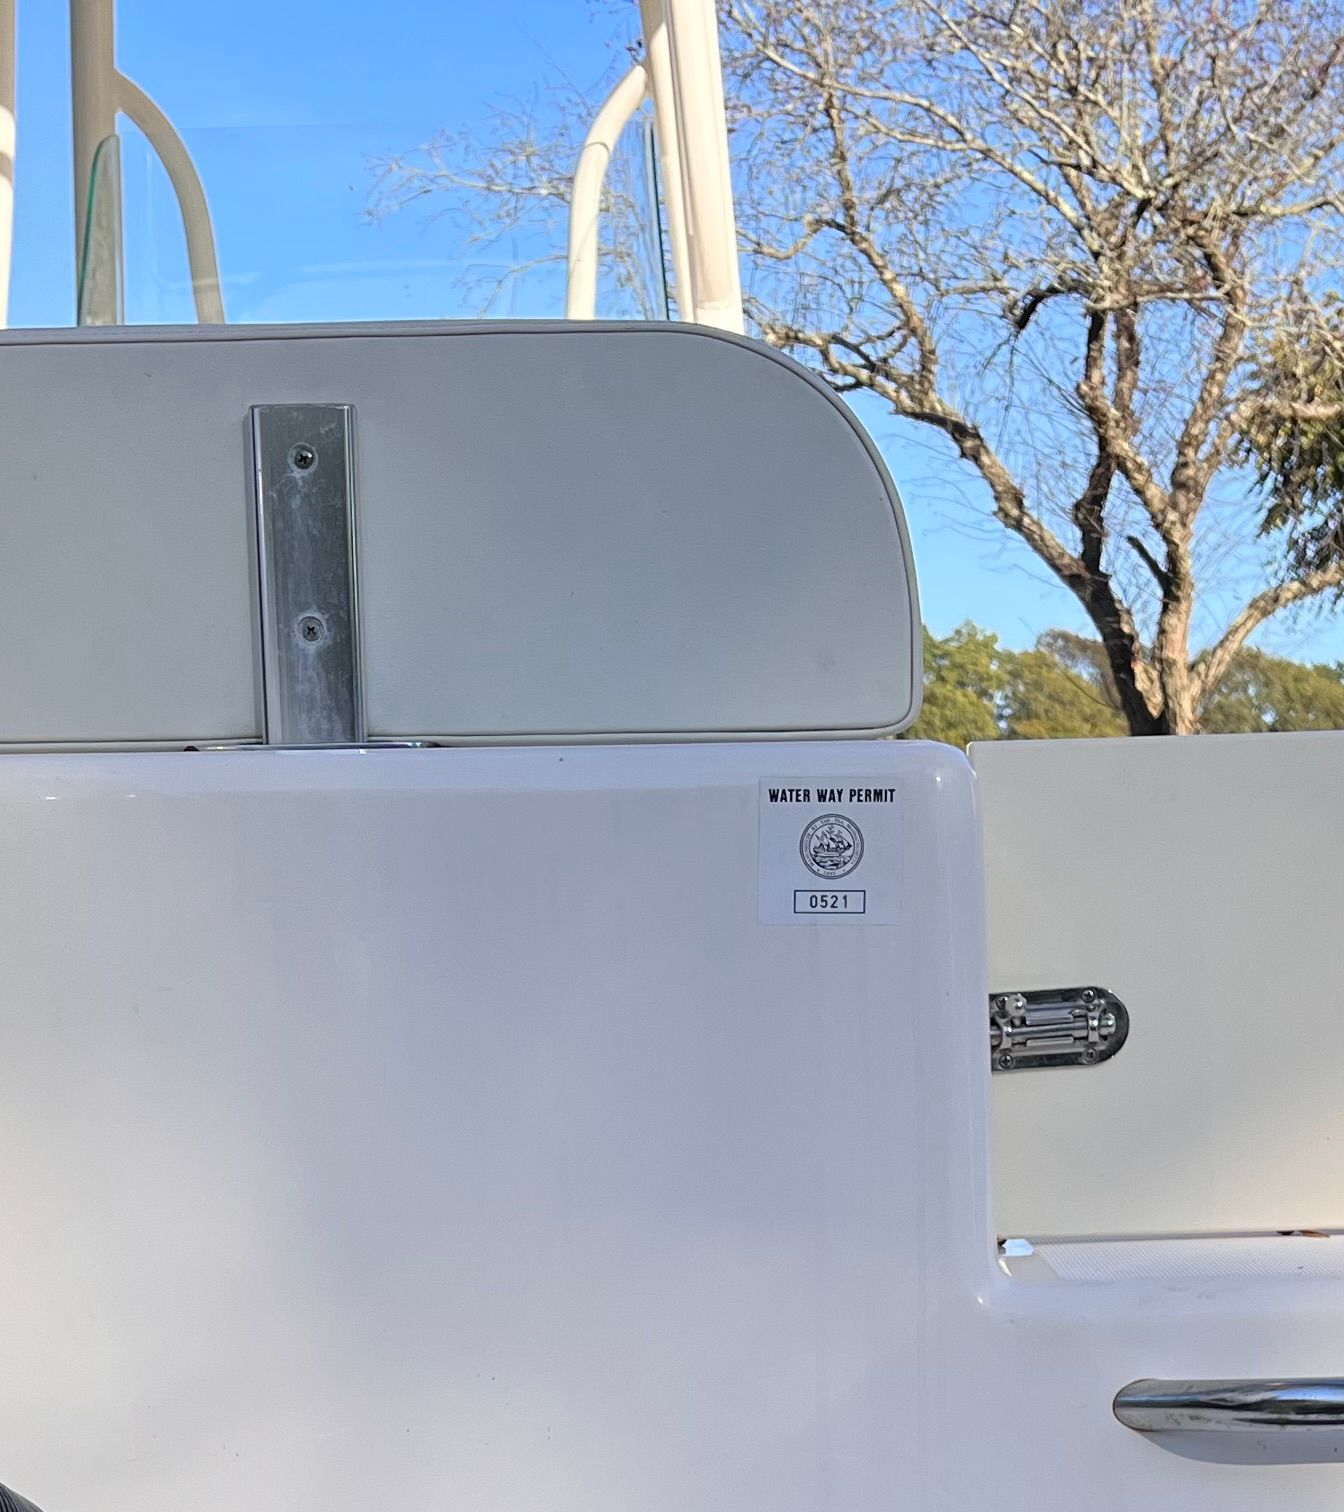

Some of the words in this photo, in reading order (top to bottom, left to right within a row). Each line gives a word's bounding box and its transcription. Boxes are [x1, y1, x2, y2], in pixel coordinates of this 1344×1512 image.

[768, 788, 811, 803] WATER
[816, 788, 844, 803] WAY
[849, 788, 896, 803] PERMIT
[809, 894, 848, 909] 0521
